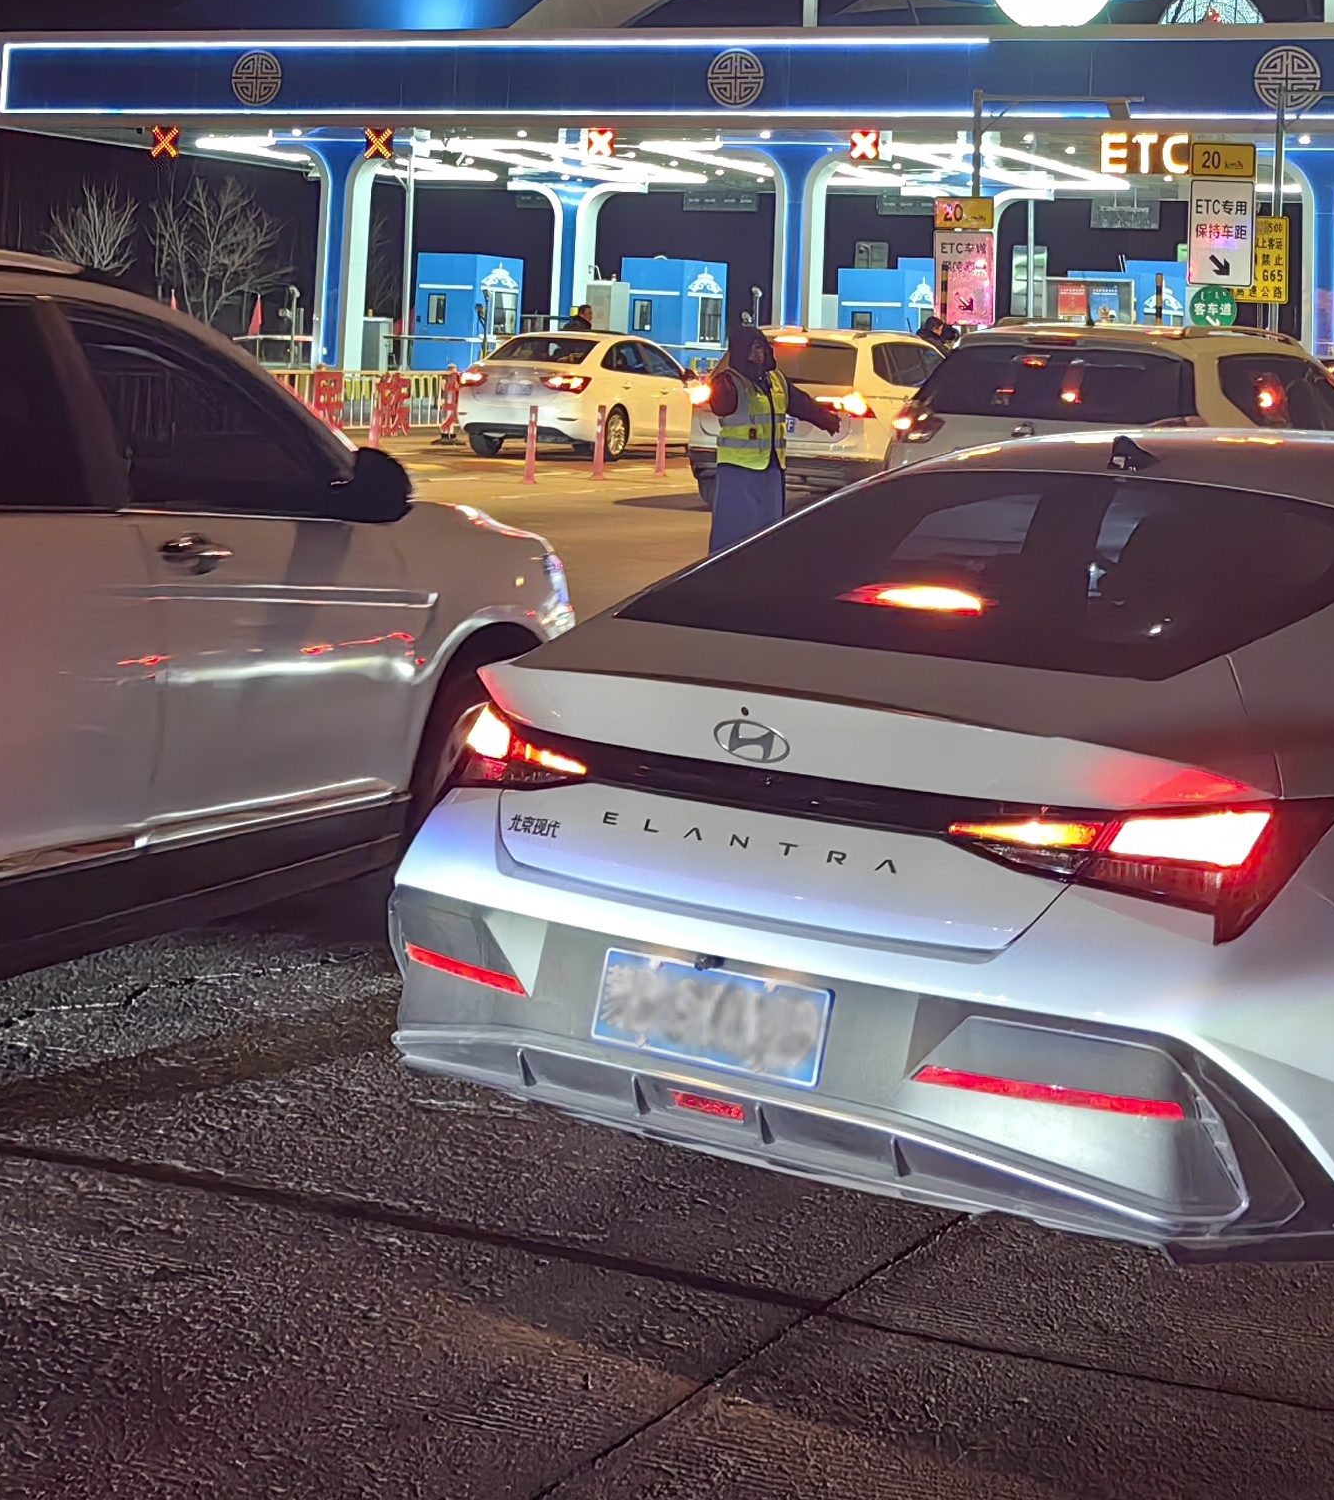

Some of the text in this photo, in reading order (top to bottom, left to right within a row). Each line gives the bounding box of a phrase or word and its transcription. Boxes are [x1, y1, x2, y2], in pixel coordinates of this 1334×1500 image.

[1100, 132, 1189, 174] ETC
[1201, 150, 1221, 169] 20
[943, 203, 964, 222] 20
[1195, 199, 1248, 216] ETC专用
[1195, 223, 1248, 239] 保持车距
[1194, 303, 1232, 316] 客车道
[508, 813, 561, 839] 北京现代
[602, 810, 898, 875] ELANTRA
